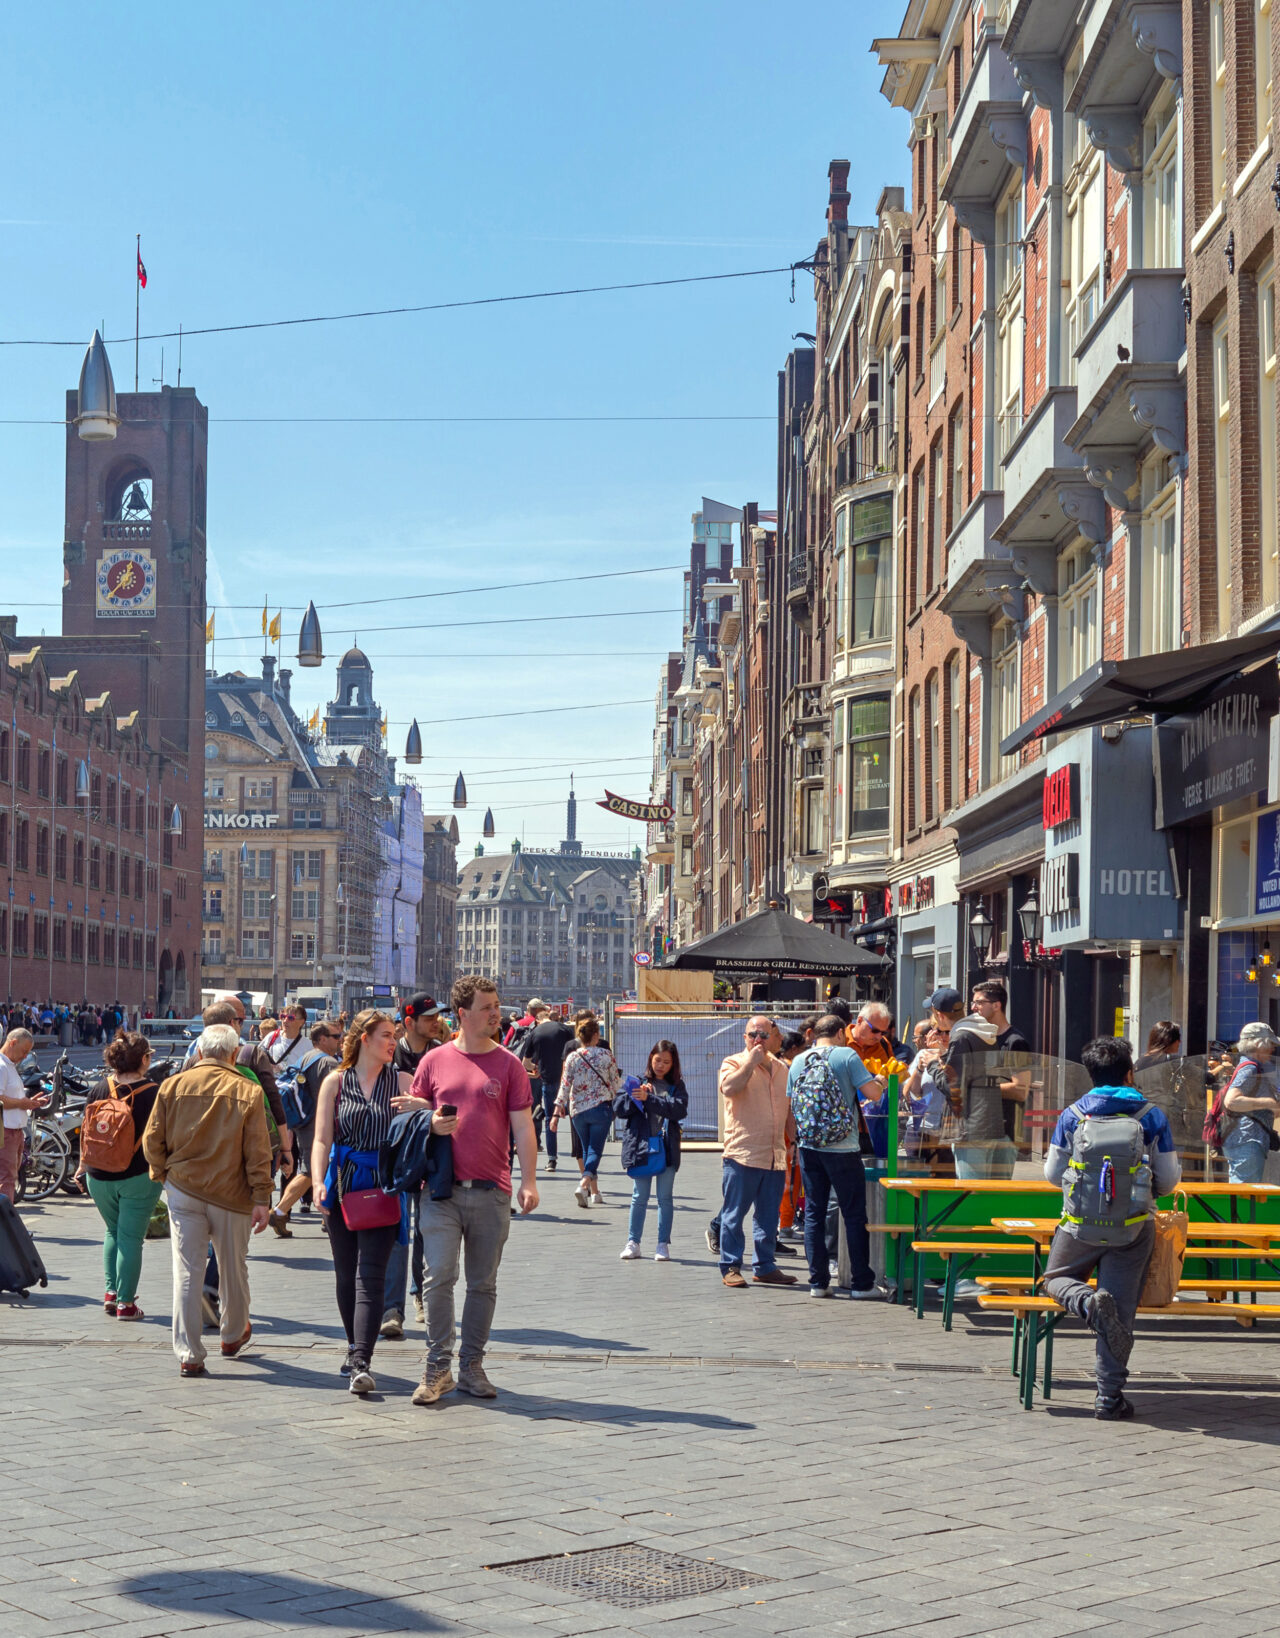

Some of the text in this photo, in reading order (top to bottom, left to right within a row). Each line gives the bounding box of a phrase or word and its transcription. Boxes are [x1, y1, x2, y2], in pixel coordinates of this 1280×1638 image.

[1181, 693, 1260, 773] MANNEKENPIS
[1043, 763, 1071, 831] DELTA
[1205, 768, 1233, 800] VLAAMSE
[1235, 758, 1255, 788] FRIET
[609, 797, 672, 819] CASINO
[1039, 853, 1070, 917] HOTEL
[1100, 869, 1170, 896] HOTEL
[715, 959, 858, 972] BRASSERIE & GRILL RESTAURANT
